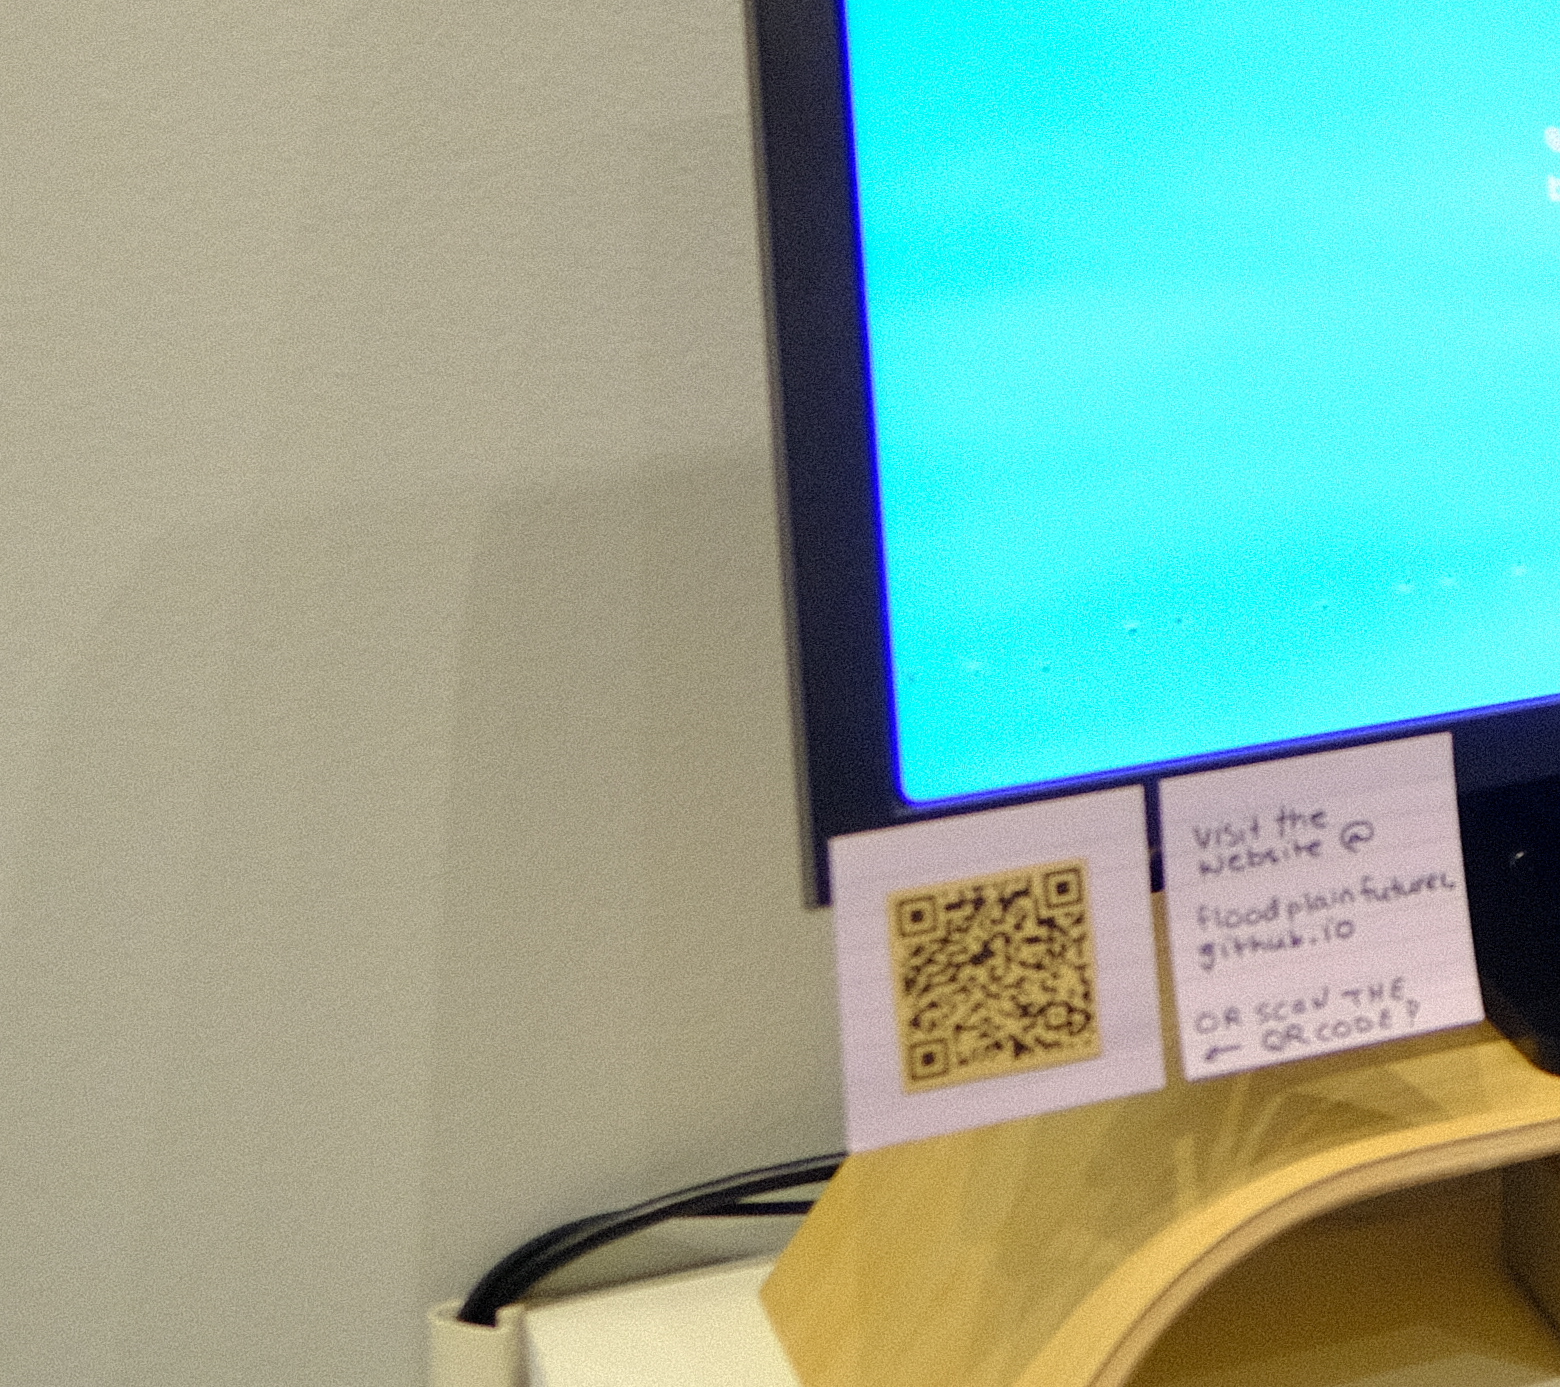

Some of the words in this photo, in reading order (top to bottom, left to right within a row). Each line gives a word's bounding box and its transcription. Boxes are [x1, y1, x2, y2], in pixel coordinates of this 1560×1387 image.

[1276, 805, 1327, 839] the
[1199, 839, 1322, 875] website
[1338, 819, 1375, 853] @
